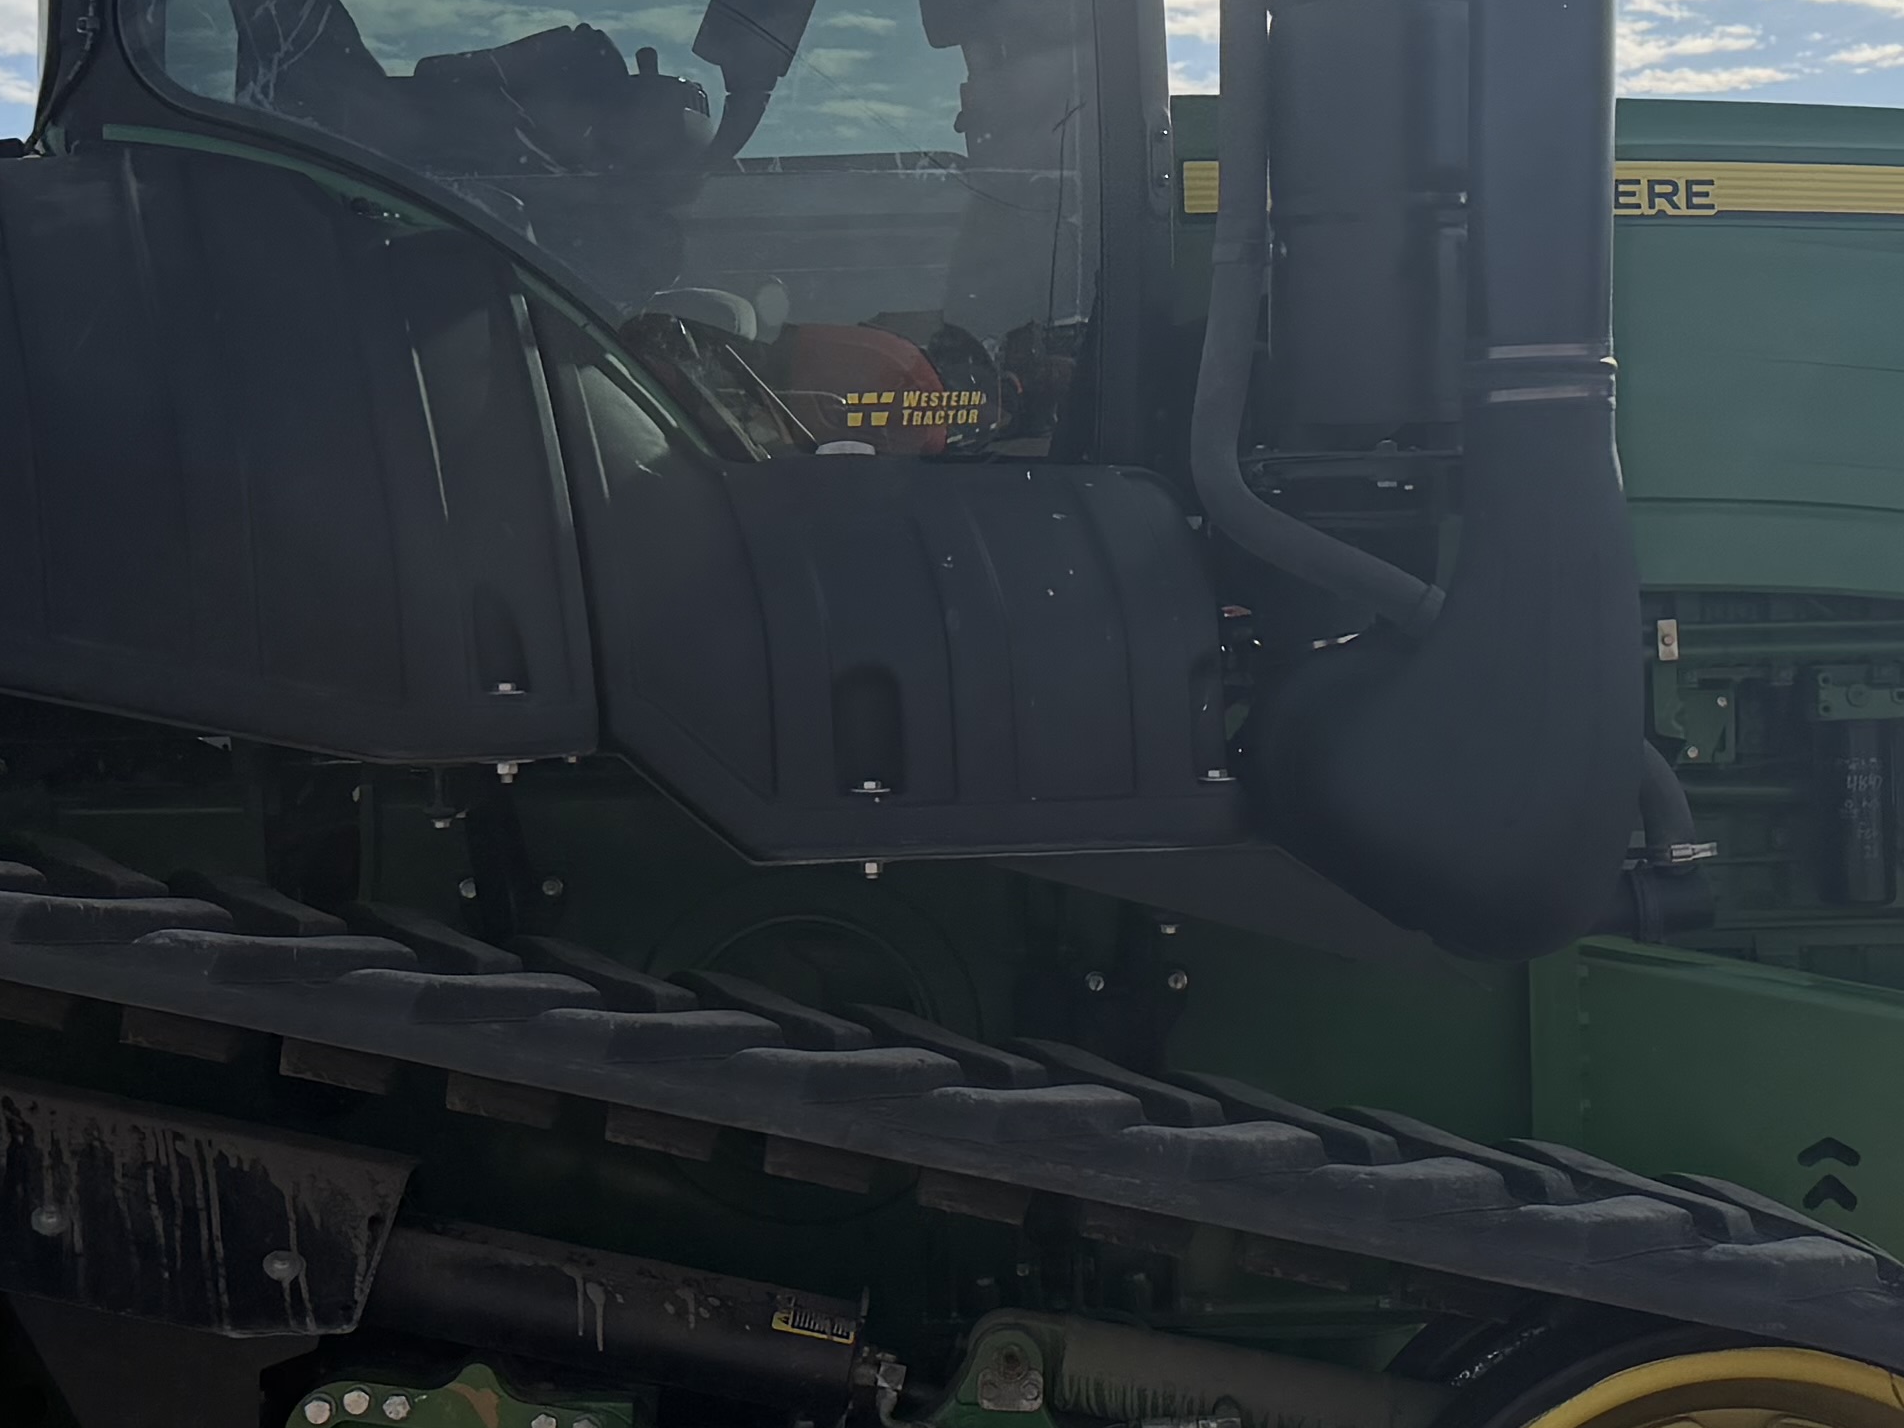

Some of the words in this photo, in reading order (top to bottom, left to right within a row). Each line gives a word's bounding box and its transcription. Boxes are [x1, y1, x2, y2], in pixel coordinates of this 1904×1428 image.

[1614, 178, 1716, 211] ERE
[902, 390, 982, 407] WESTERN
[901, 409, 979, 426] TRACTOR
